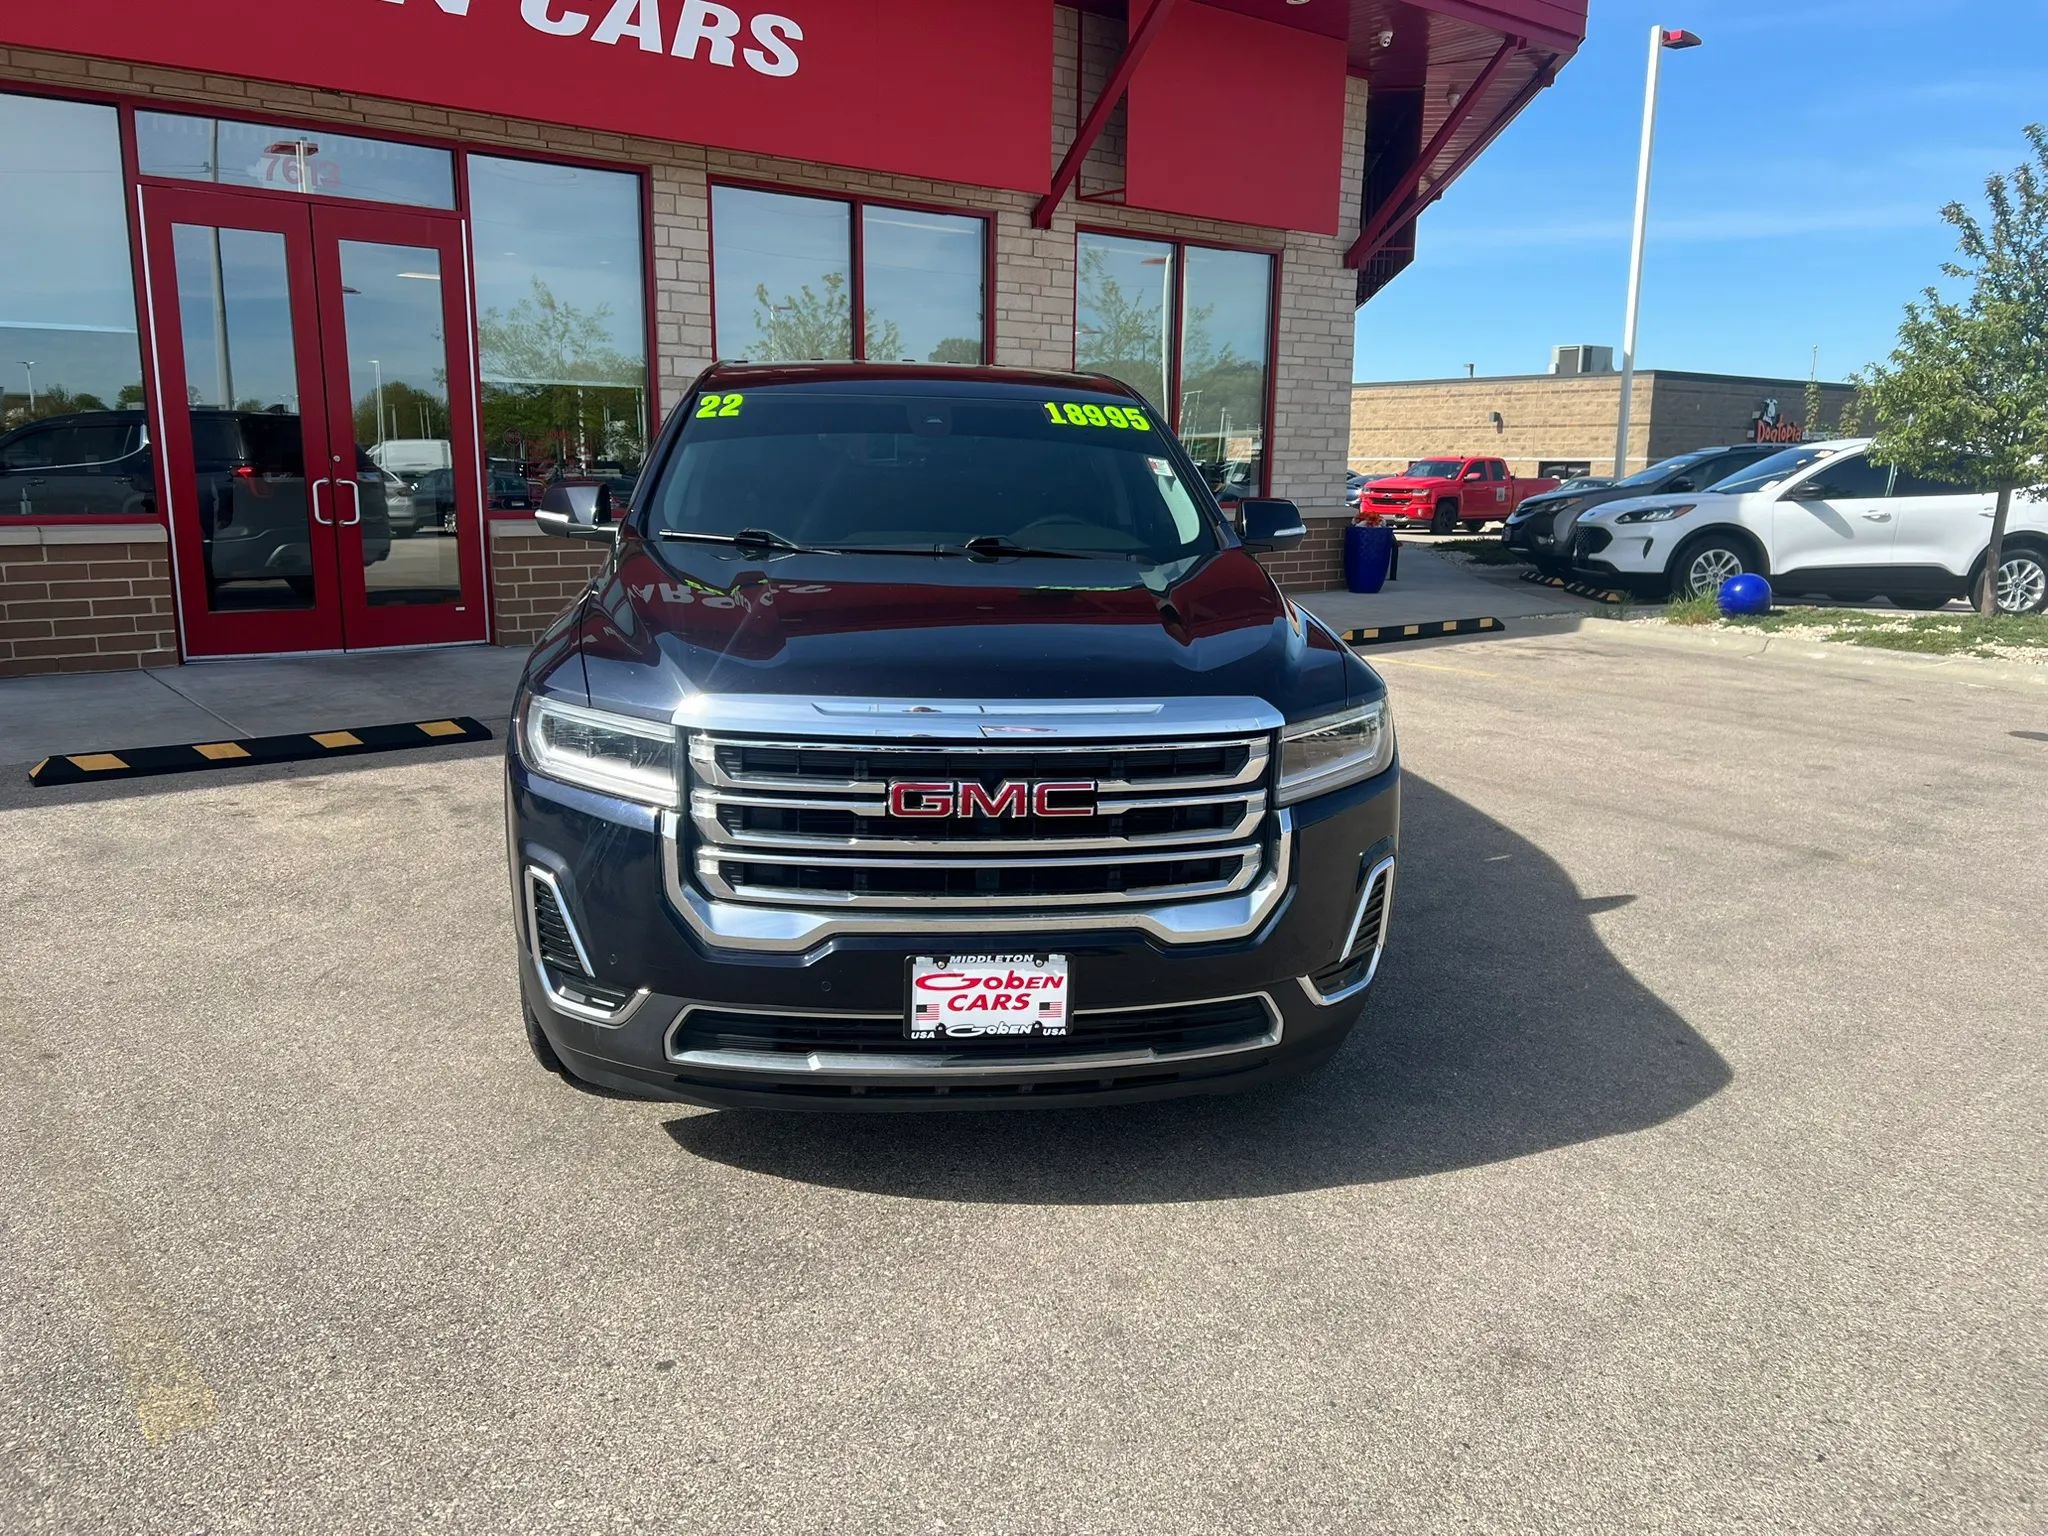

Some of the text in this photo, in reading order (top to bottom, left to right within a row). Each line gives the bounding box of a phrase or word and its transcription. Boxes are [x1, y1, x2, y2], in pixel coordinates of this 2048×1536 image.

[520, 0, 804, 78] CARS
[695, 393, 744, 418] 22
[1044, 402, 1151, 431] 18995
[889, 779, 1095, 818] GMC
[949, 954, 1034, 964] MIDDLETON
[947, 993, 1033, 1012] CARS
[911, 1030, 936, 1039] USA
[1042, 1028, 1067, 1036] USA
